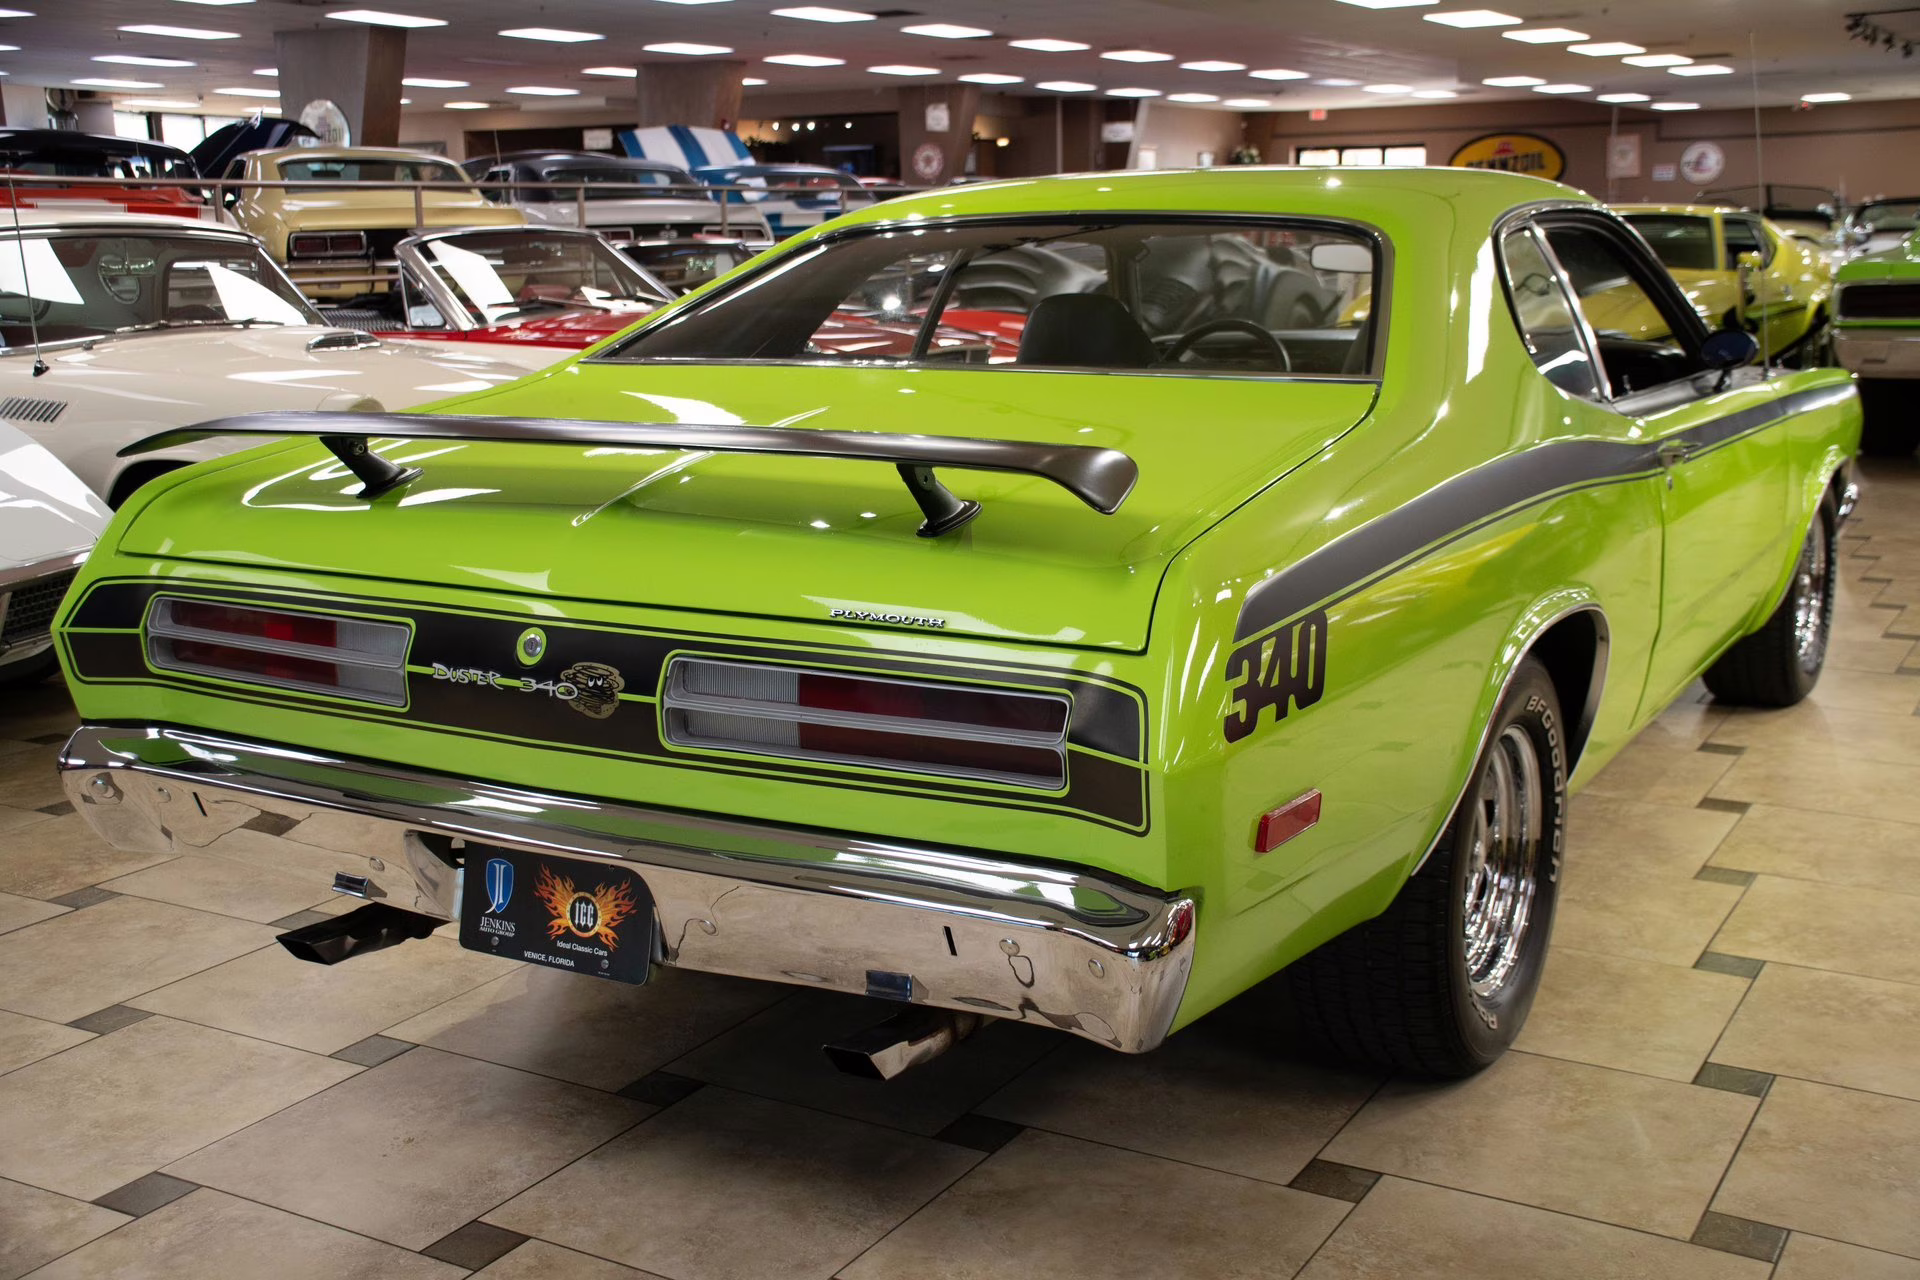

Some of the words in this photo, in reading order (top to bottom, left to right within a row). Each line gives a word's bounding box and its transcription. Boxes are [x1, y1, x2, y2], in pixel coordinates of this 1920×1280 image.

[829, 608, 946, 629] PLYMOUTH
[432, 662, 504, 690] DUSTER
[519, 677, 579, 700] 340
[1224, 611, 1328, 744] 340
[479, 916, 516, 933] JENKINS
[556, 940, 572, 950] Ideal
[572, 943, 593, 954] Classic
[593, 948, 608, 957] Cars
[523, 950, 548, 962] VENICE,
[548, 956, 575, 968] FLORIDA
